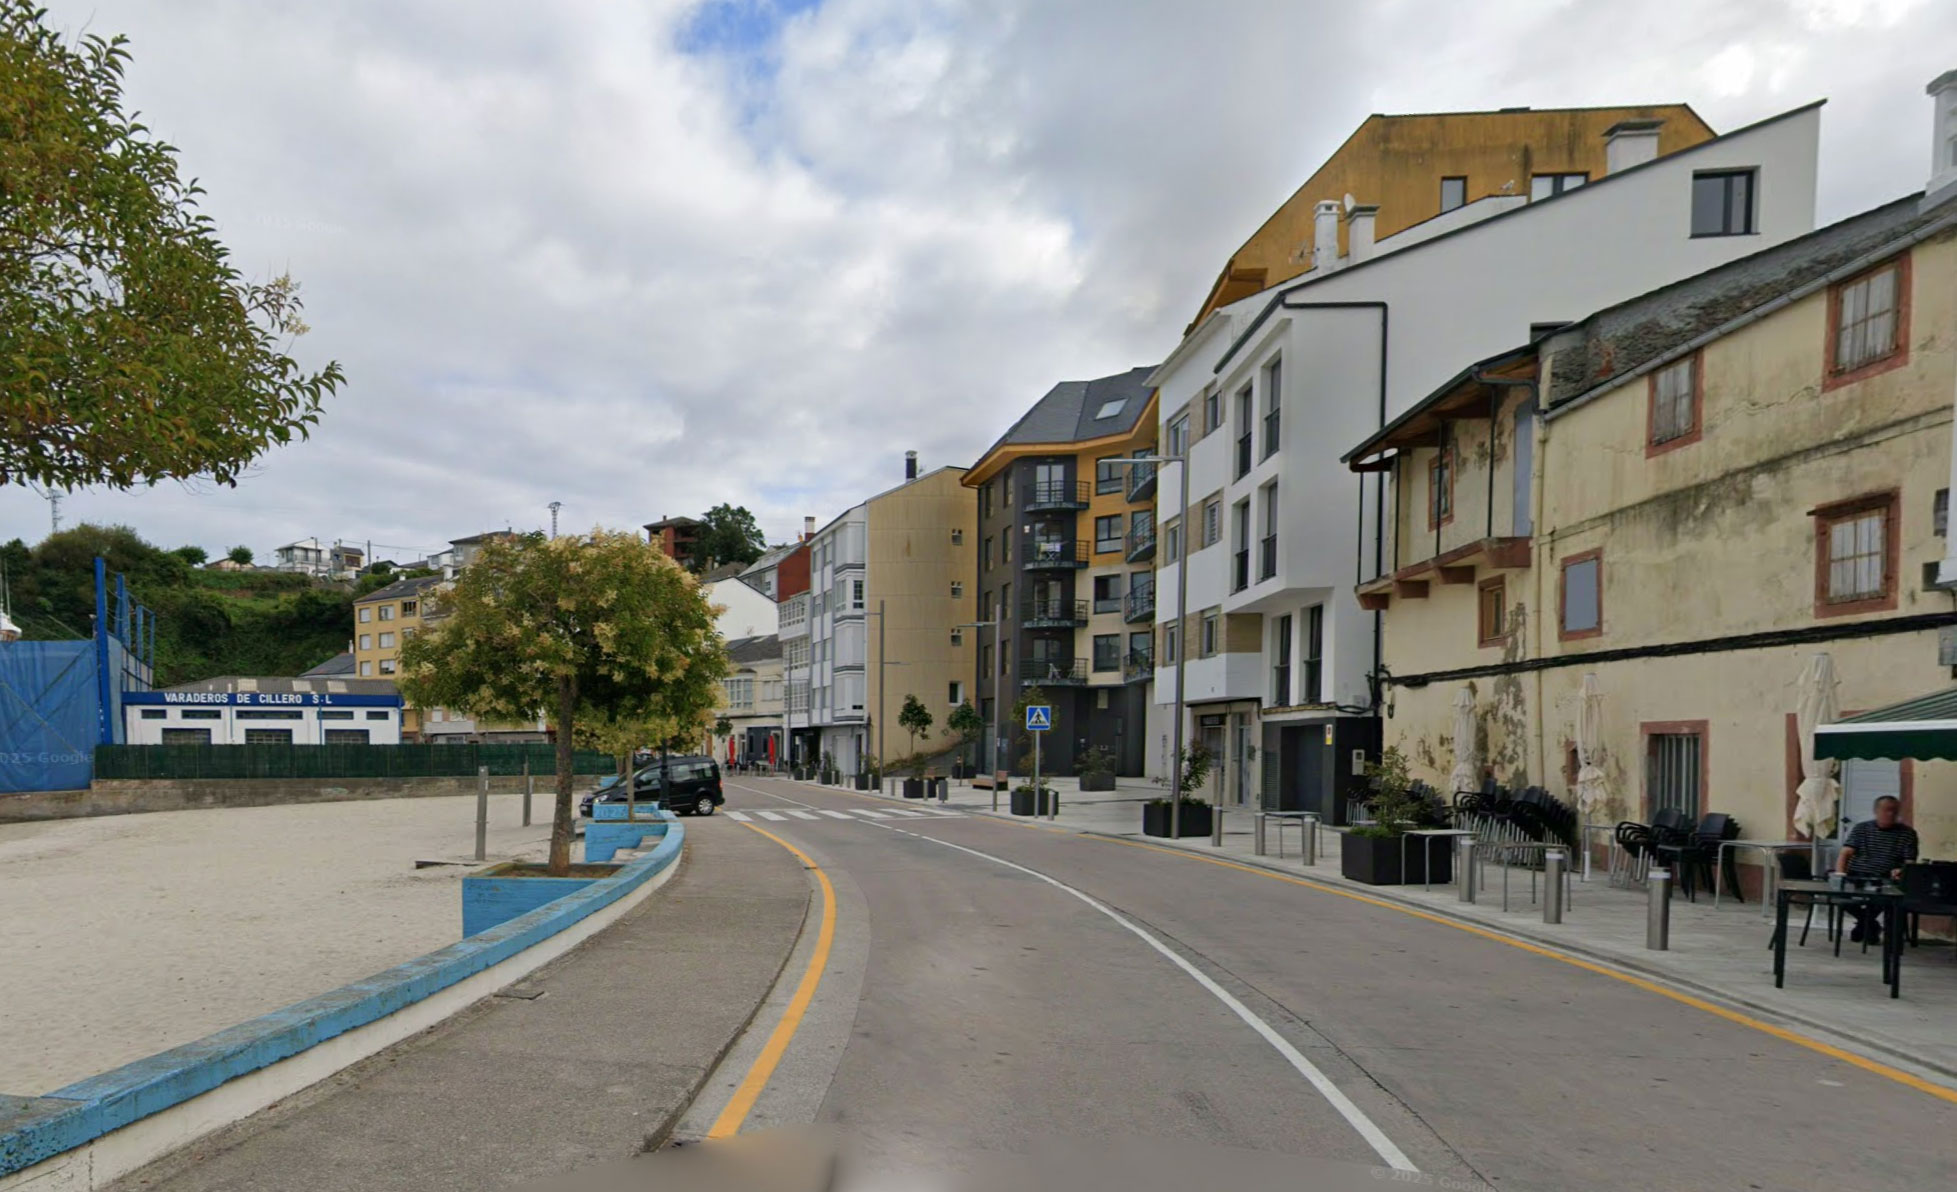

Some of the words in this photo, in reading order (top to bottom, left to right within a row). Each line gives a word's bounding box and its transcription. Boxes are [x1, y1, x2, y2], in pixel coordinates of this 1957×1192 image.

[164, 692, 229, 704] VARADEROS
[236, 693, 251, 704] DE
[259, 693, 303, 704] CILLERO
